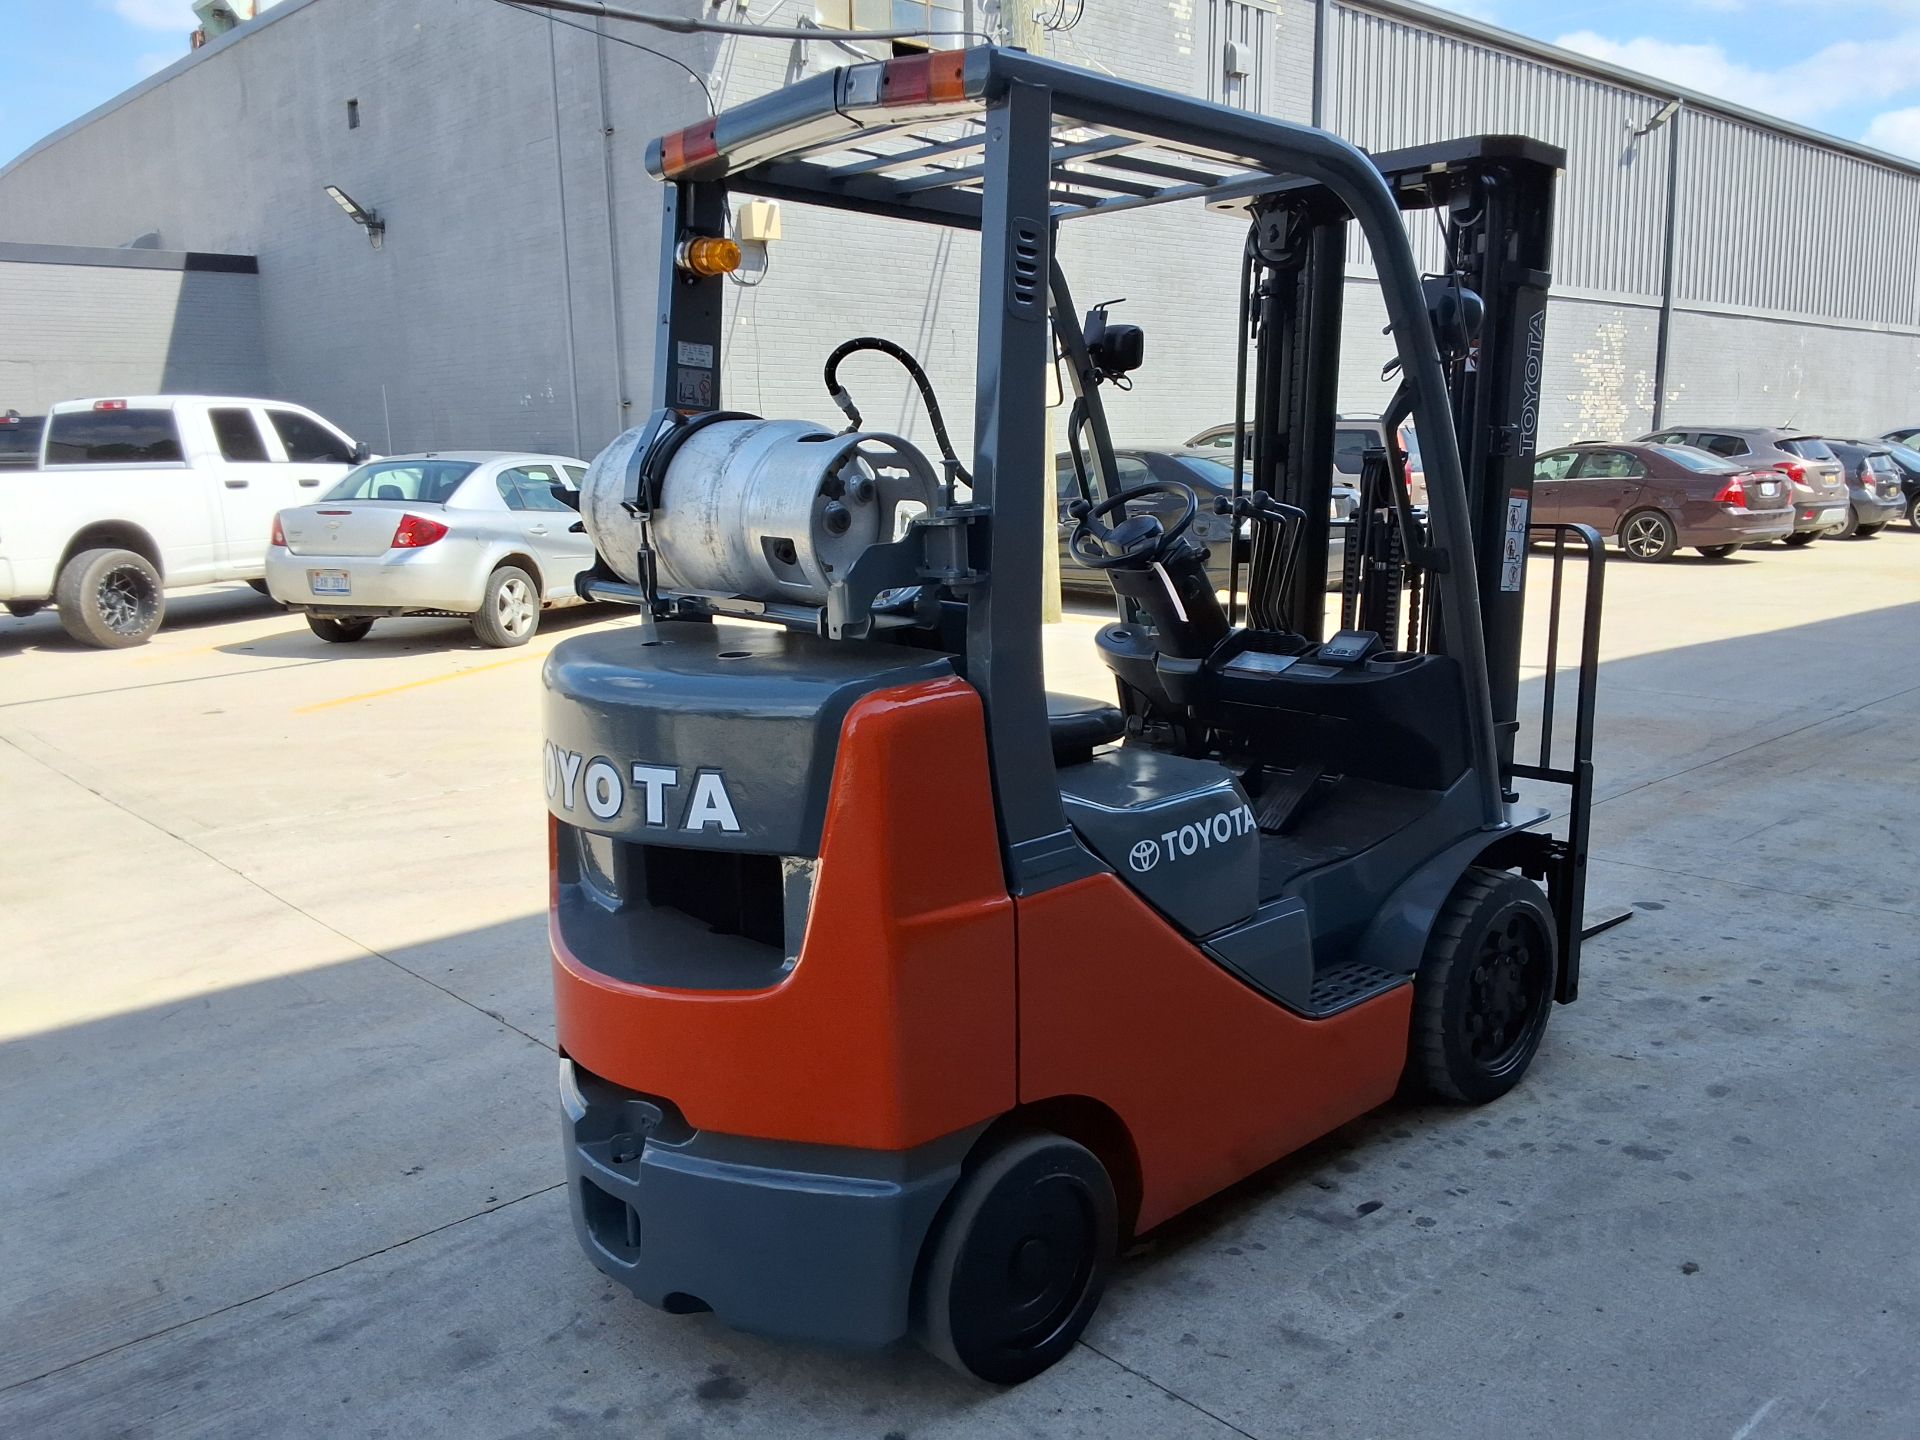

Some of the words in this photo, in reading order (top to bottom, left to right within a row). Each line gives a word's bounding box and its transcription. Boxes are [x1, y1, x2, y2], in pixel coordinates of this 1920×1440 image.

[1519, 309, 1545, 457] TOYOTA
[544, 739, 745, 834] OYOTA
[1161, 804, 1257, 861] TOYOTA
